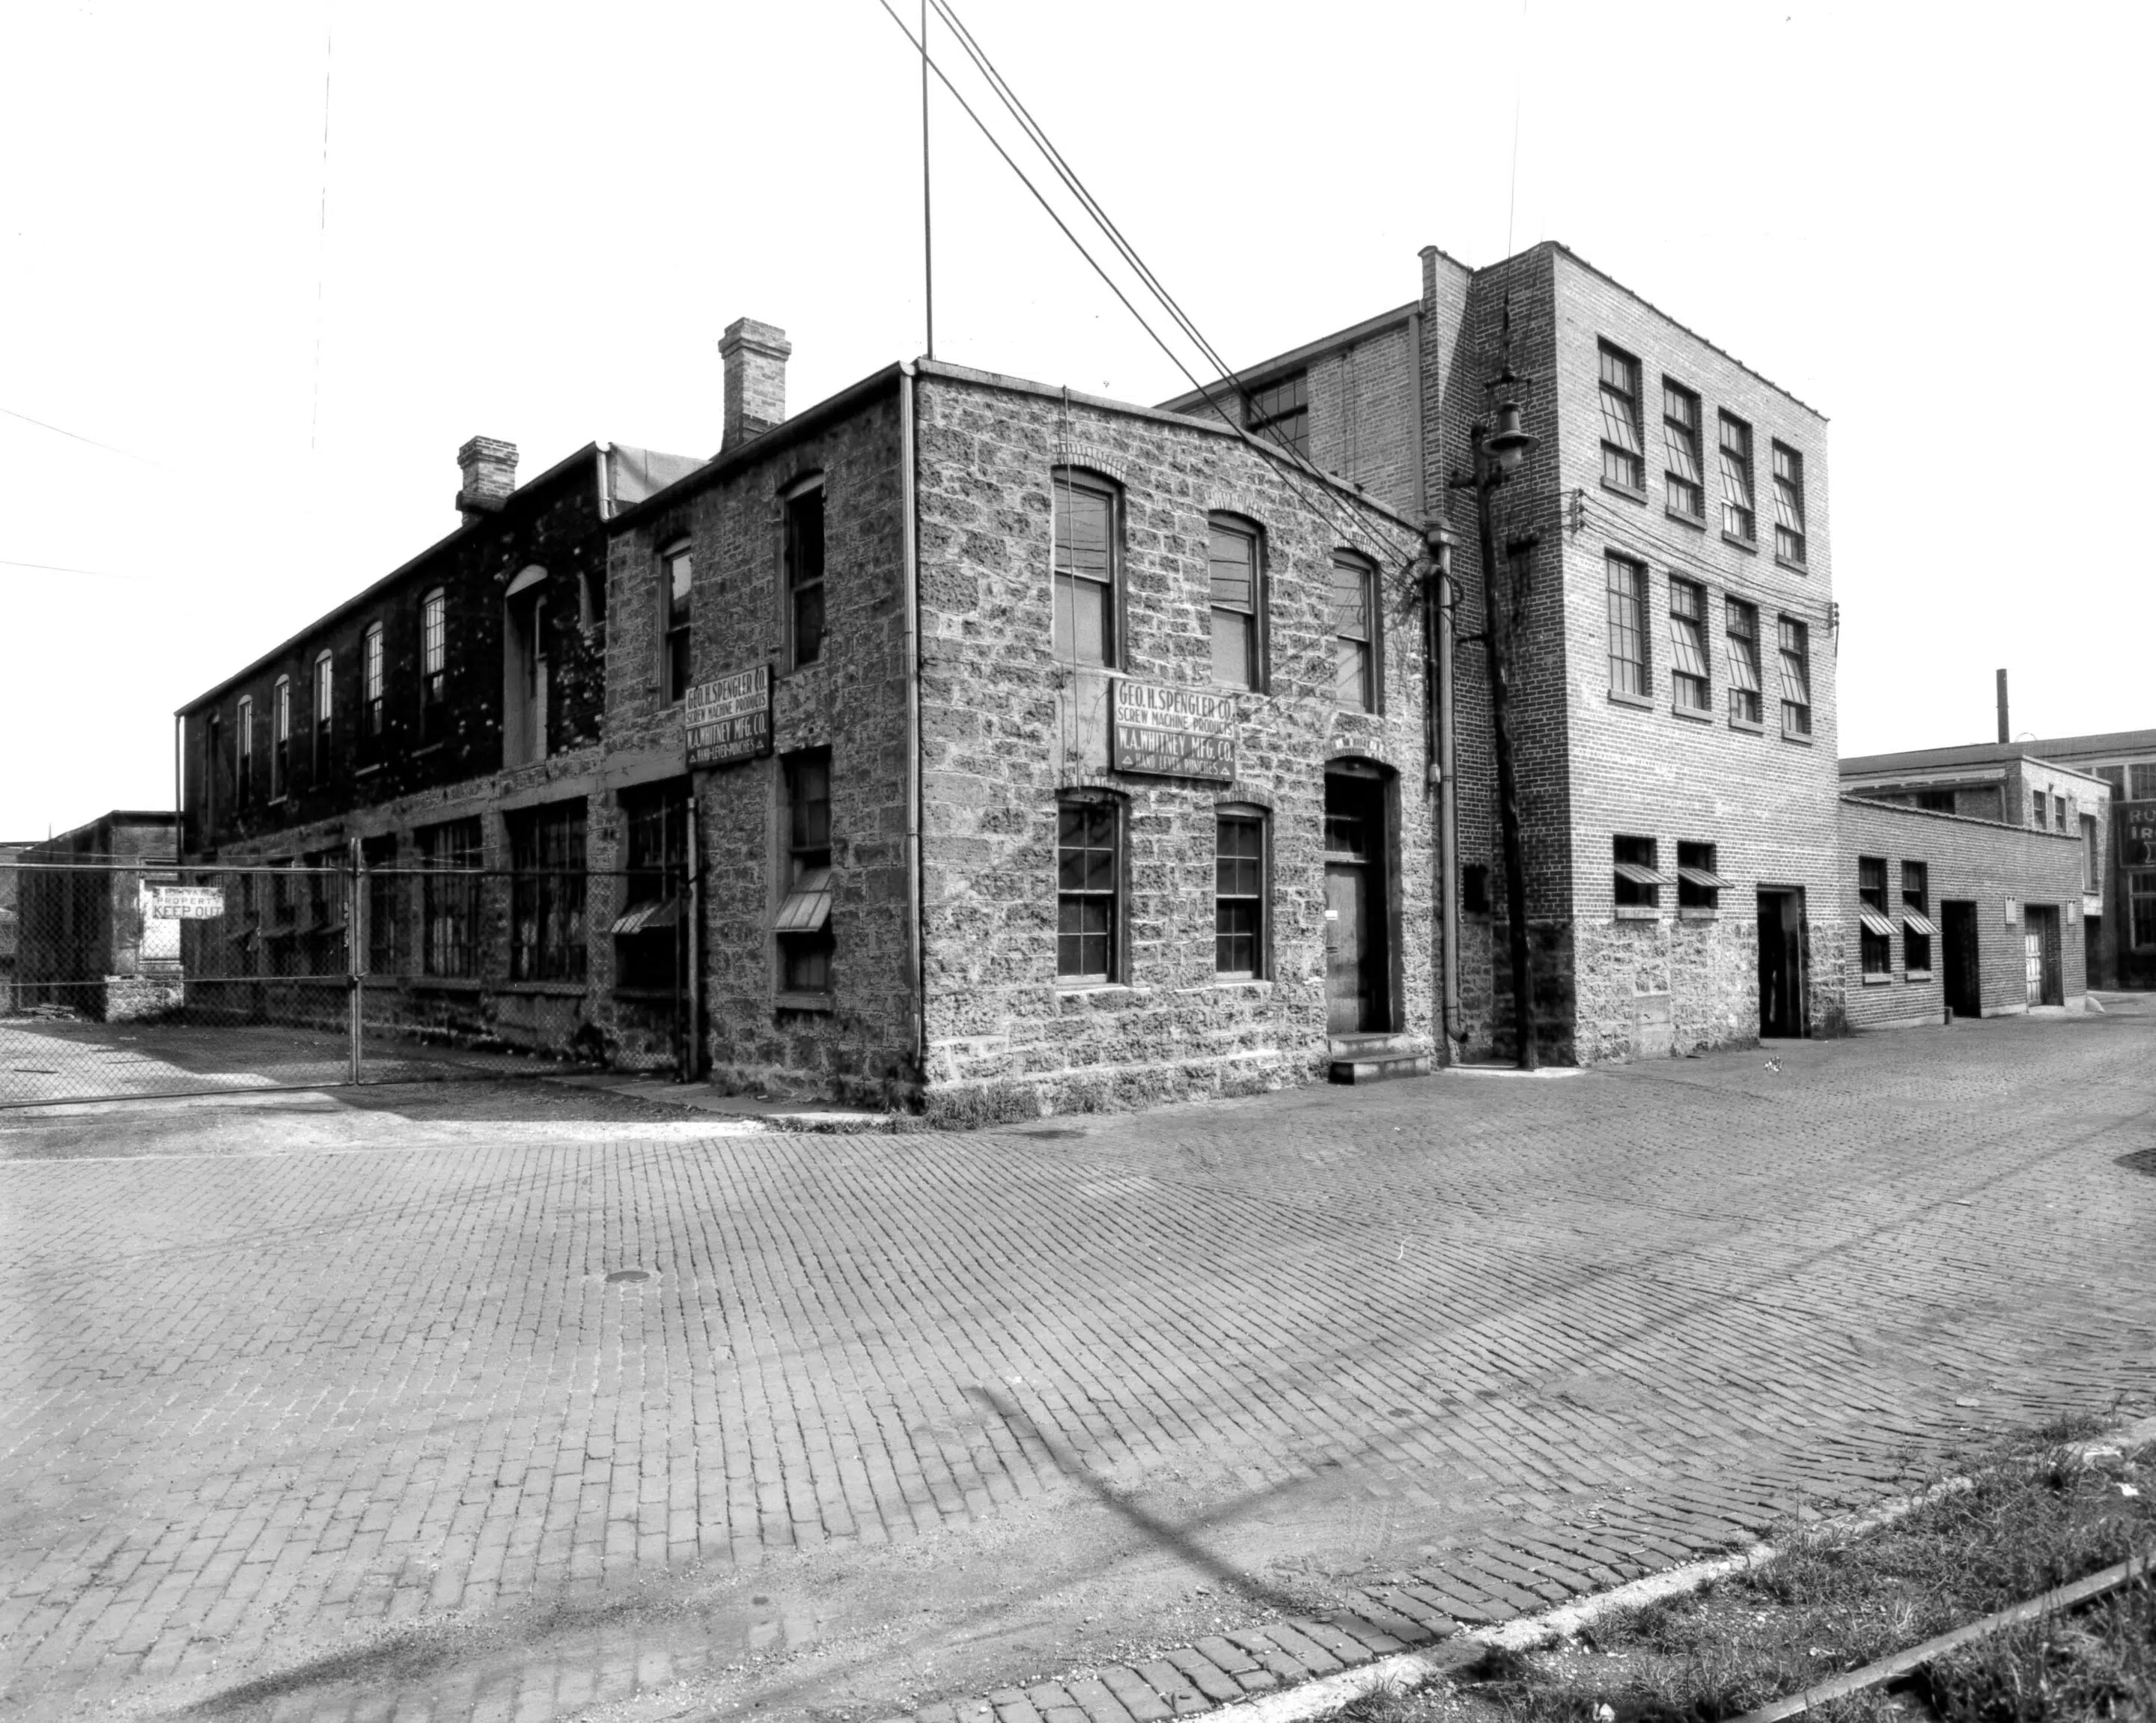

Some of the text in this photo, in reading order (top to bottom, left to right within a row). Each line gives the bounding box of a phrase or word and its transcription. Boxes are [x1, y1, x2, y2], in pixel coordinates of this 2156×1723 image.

[688, 687, 704, 710] GEO.
[713, 674, 752, 703] SPENGLER
[755, 668, 767, 691] CO.
[1119, 682, 1145, 707] GEO.
[1159, 690, 1214, 718] SPENGLER
[736, 692, 766, 713] PRODUCTS
[734, 716, 752, 739] MFG.
[754, 713, 767, 734] CO.
[1118, 707, 1232, 736] SCREW MACHINE PRODUCTS
[1192, 737, 1215, 759] MFG.
[1218, 741, 1234, 762] CO.
[1136, 753, 1155, 768] HAND
[1184, 758, 1219, 775] PUNCHES
[154, 906, 222, 918] KEEP OUT
